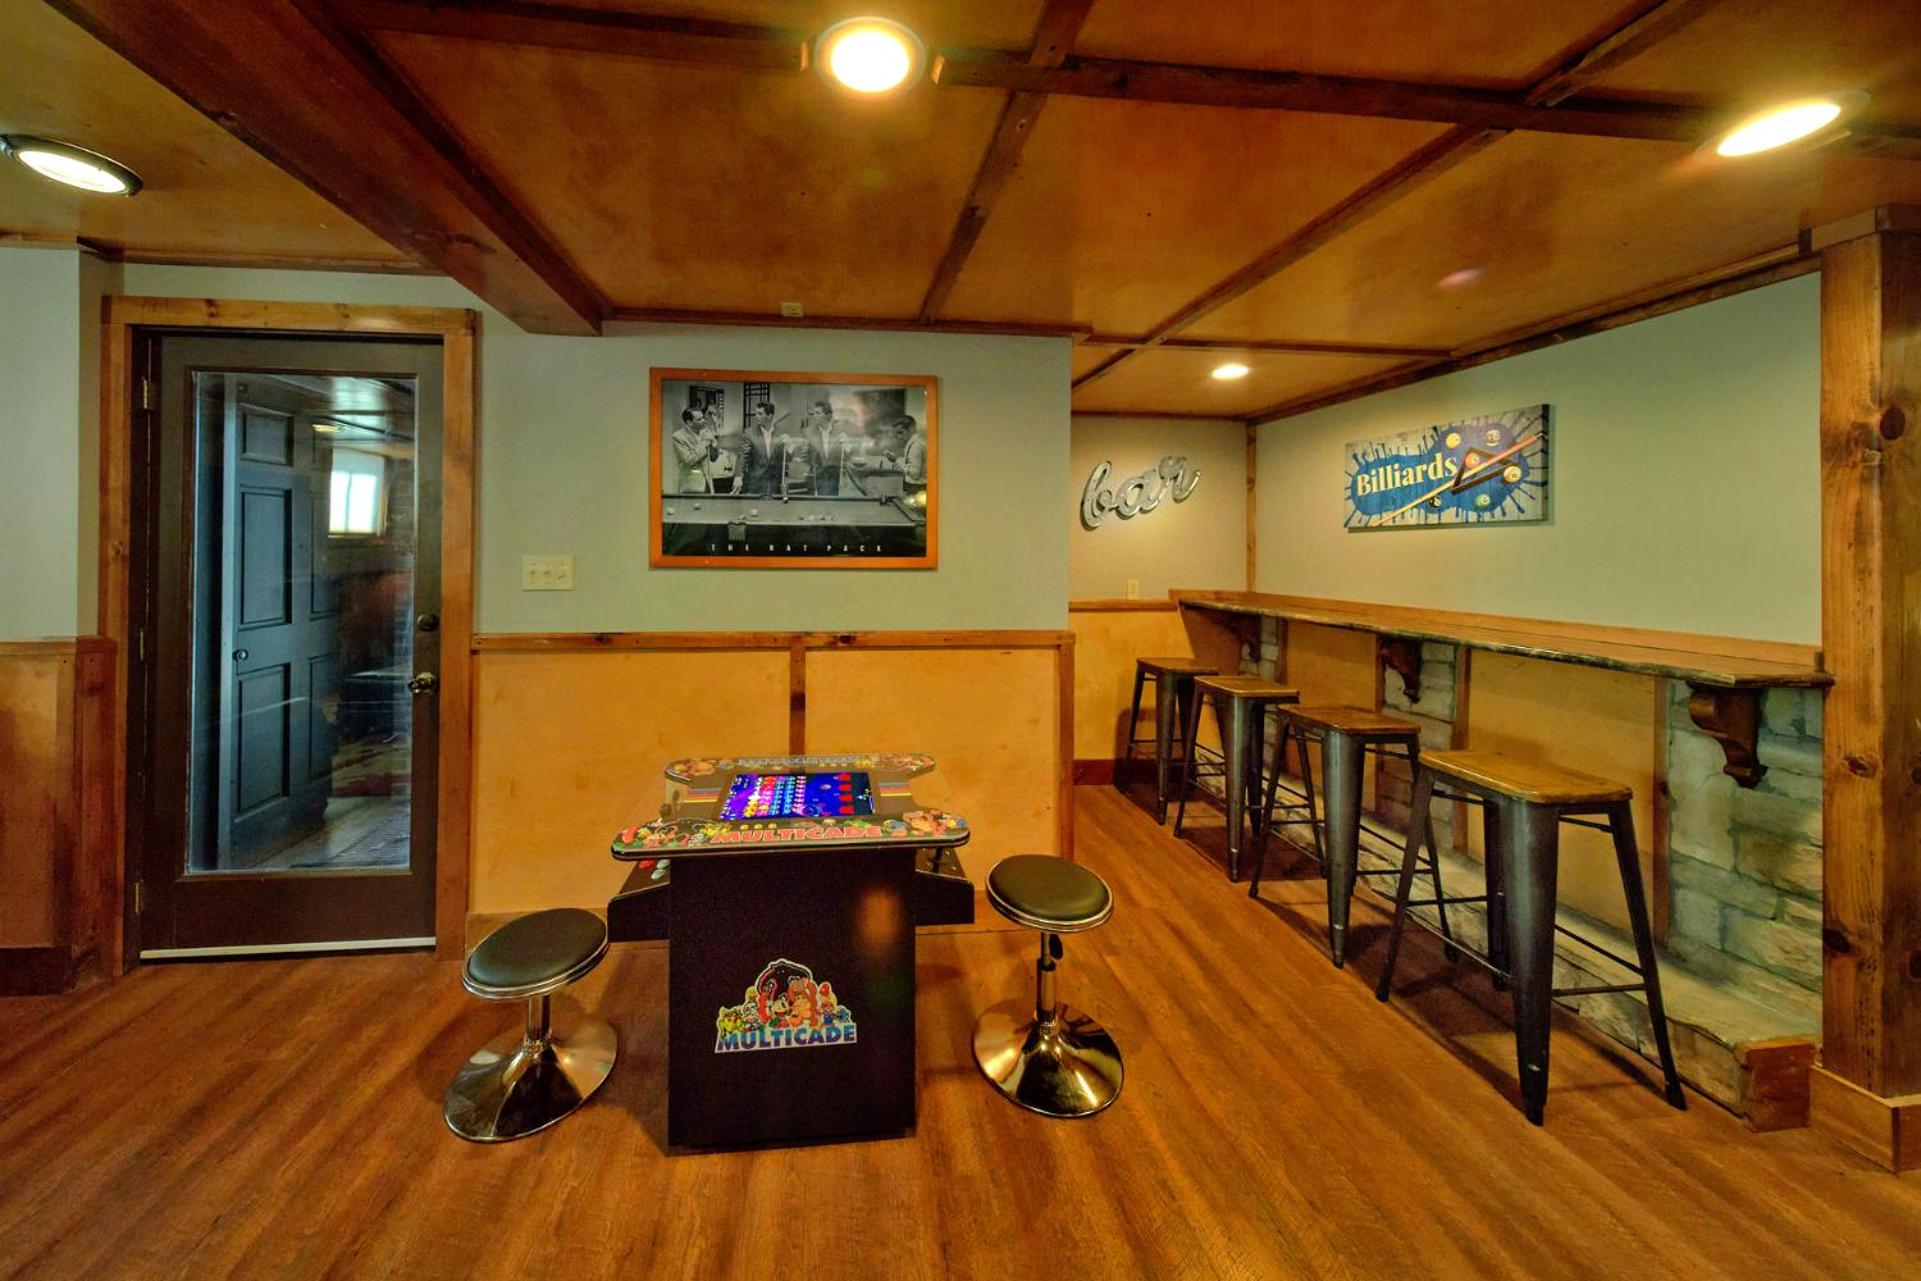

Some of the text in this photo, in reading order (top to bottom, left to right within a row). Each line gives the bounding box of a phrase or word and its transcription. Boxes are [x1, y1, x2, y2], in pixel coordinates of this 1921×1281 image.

[1357, 452, 1458, 496] Billiards
[1082, 456, 1200, 528] bar
[826, 543, 881, 552] PACK
[710, 826, 881, 844] MULTICADE
[717, 1024, 856, 1051] MULTICADE
